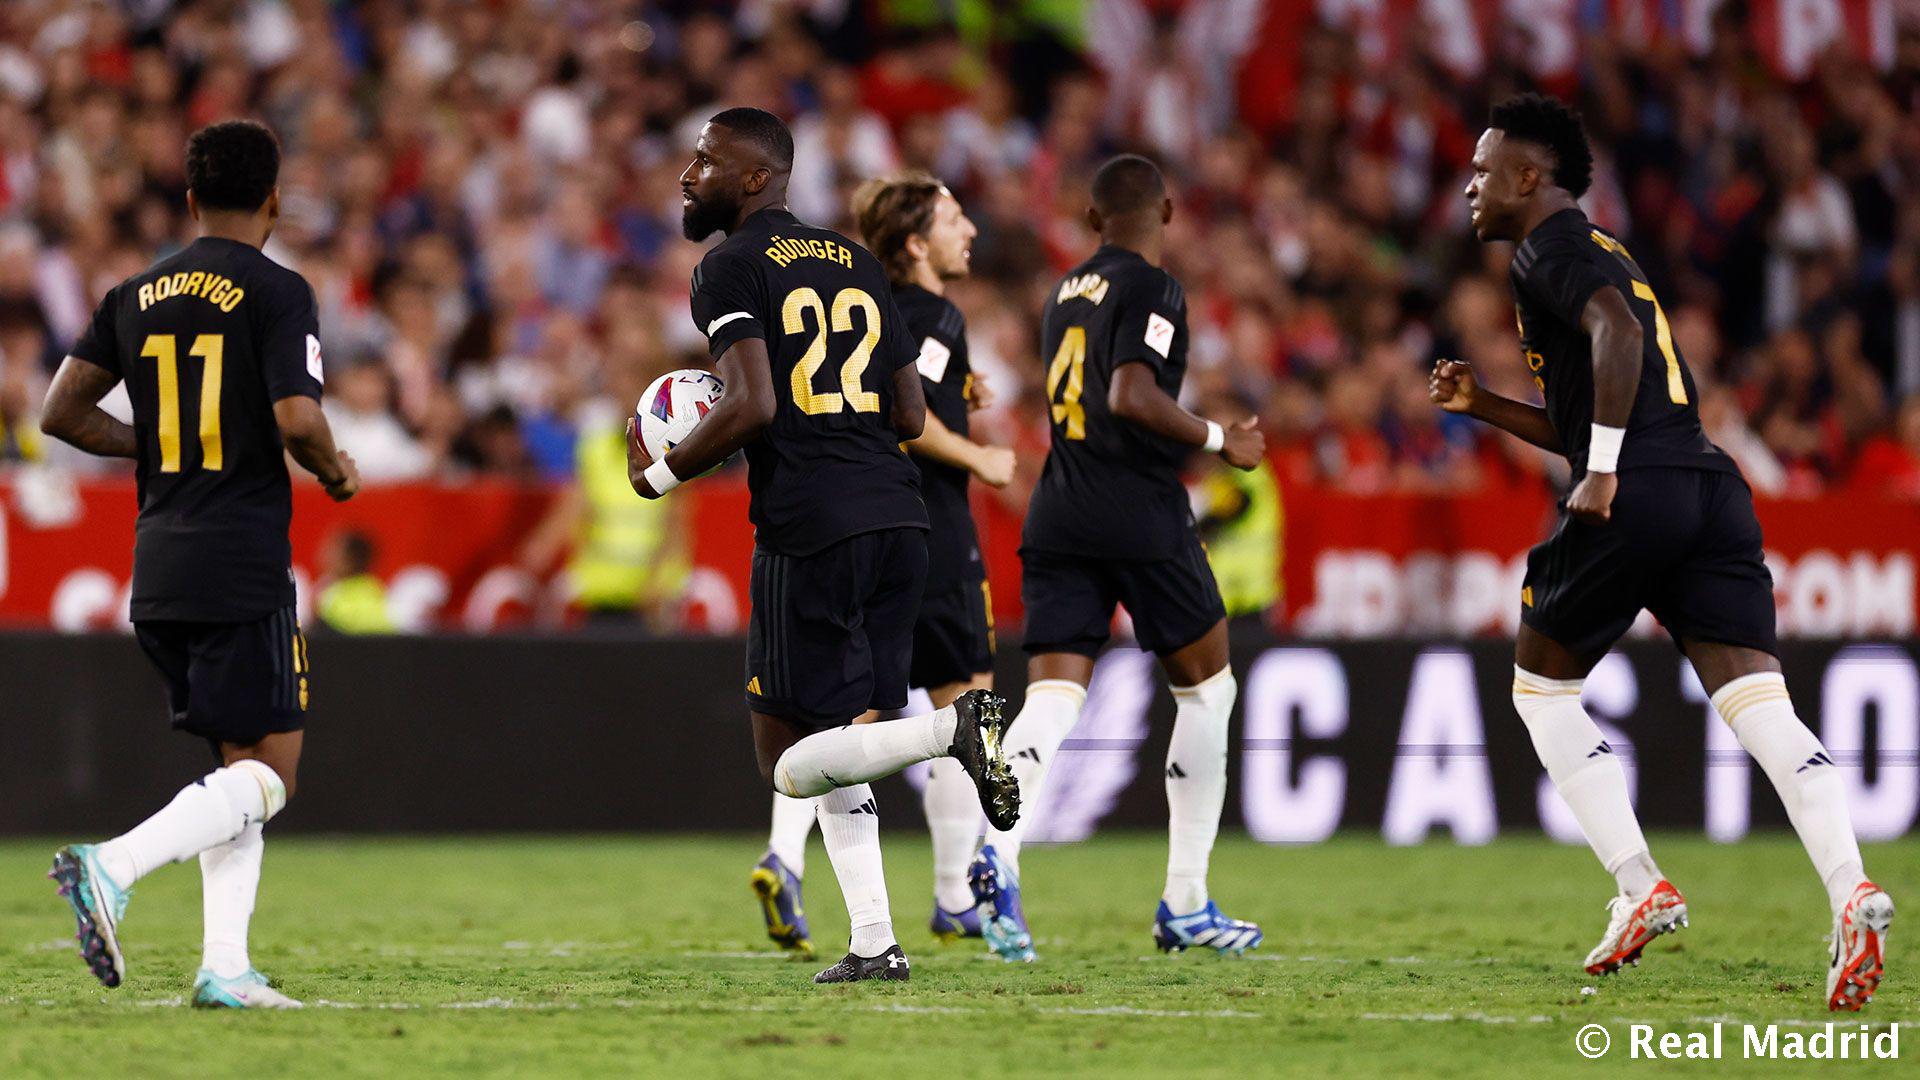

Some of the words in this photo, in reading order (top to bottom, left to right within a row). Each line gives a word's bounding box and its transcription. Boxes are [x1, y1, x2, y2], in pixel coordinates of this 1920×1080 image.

[138, 271, 245, 313] RODRYGO
[765, 235, 853, 270] RÜDIGER
[782, 287, 882, 416] 22
[1047, 326, 1086, 440] 4
[1631, 279, 1689, 405] 7
[140, 334, 224, 473] 11
